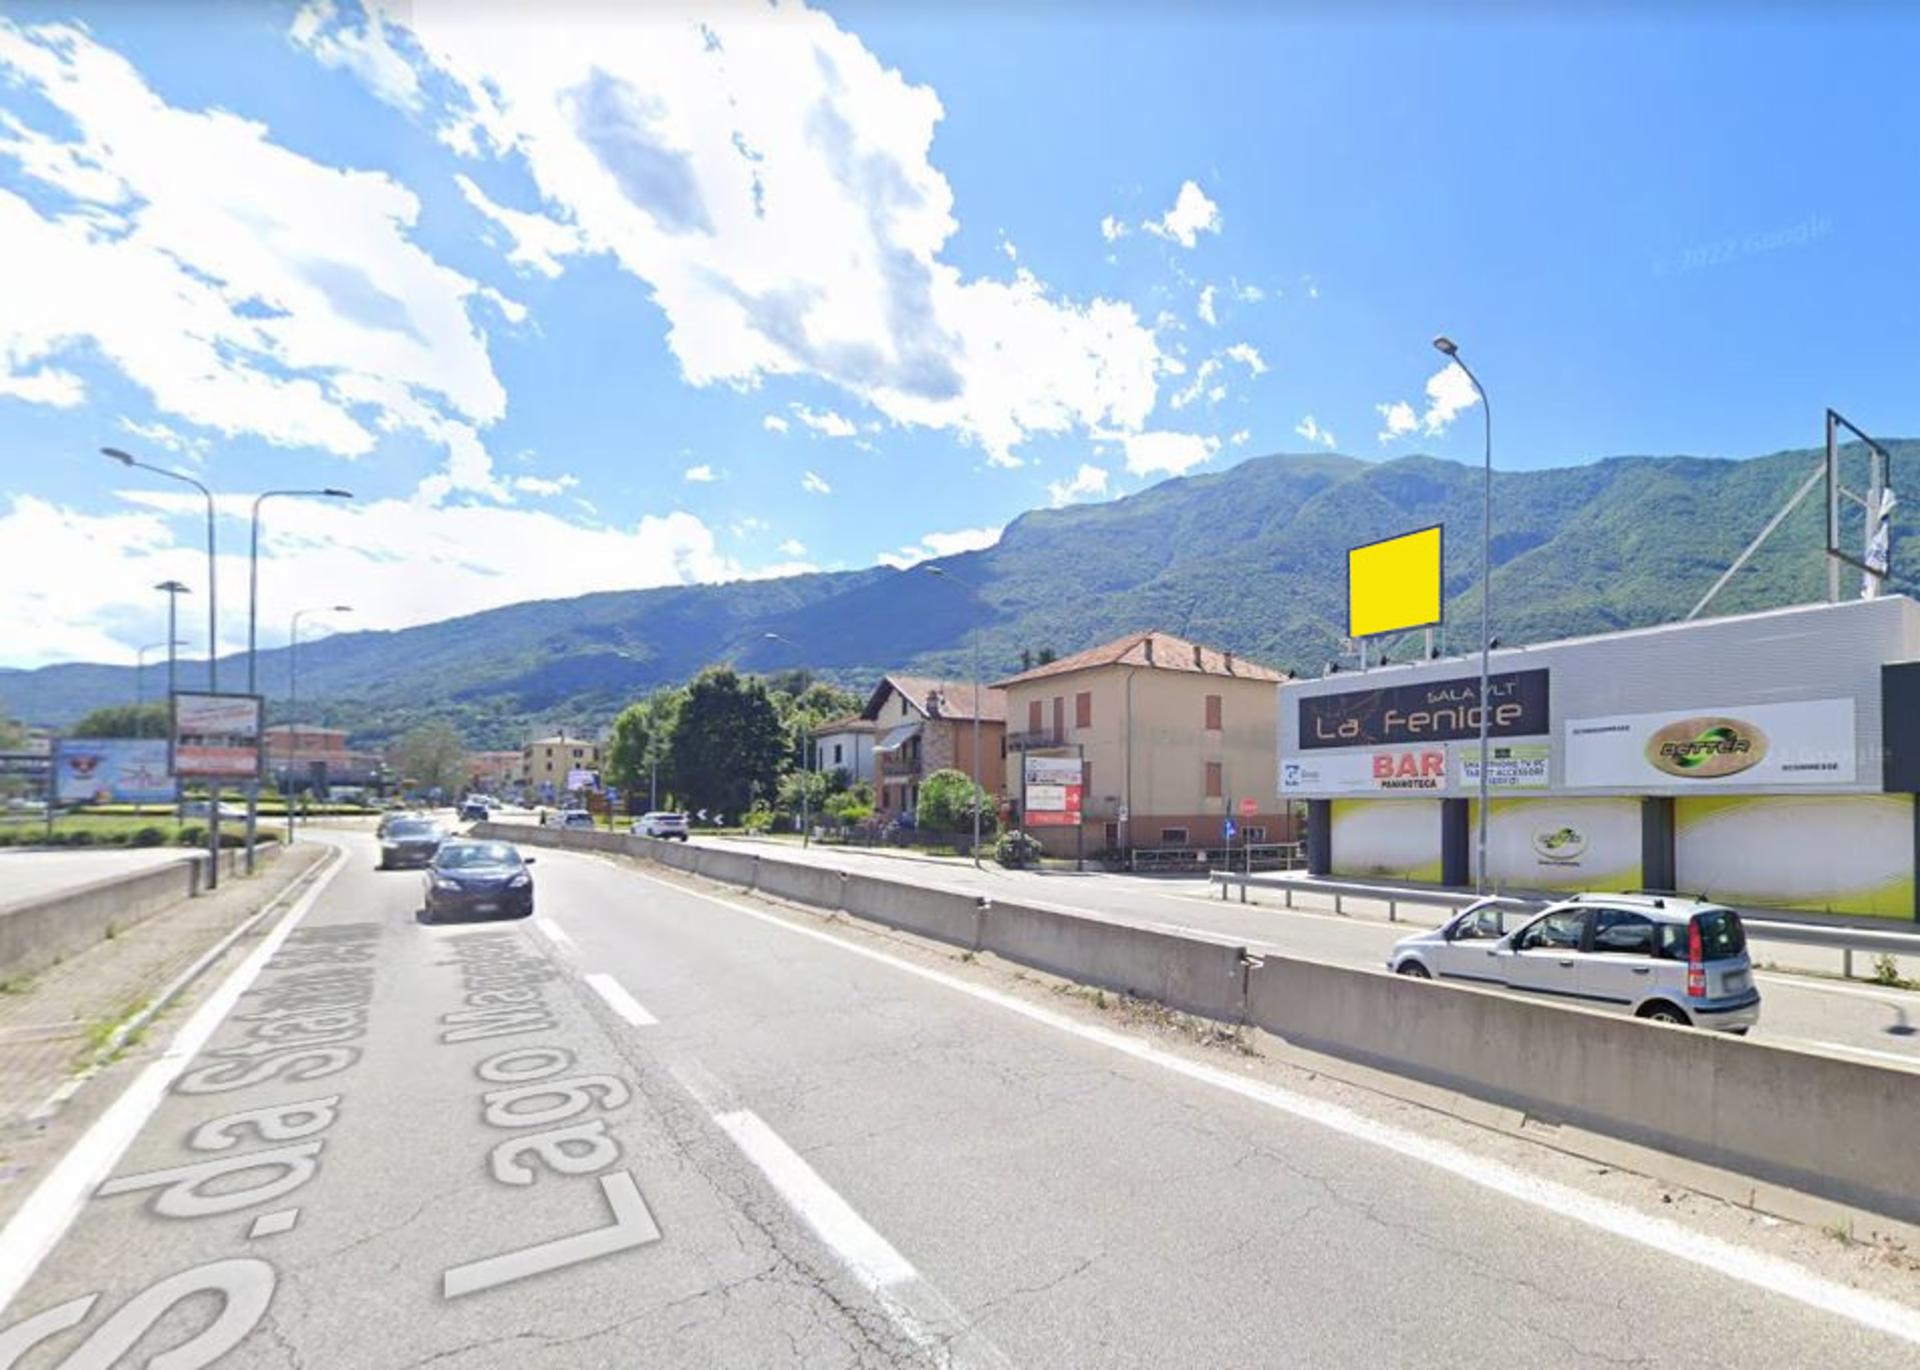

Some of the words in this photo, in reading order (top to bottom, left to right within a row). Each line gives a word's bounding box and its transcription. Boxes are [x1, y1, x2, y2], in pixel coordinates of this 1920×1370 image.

[1427, 686, 1475, 704] SALA
[1316, 716, 1360, 739] La
[1372, 750, 1445, 778] BAR
